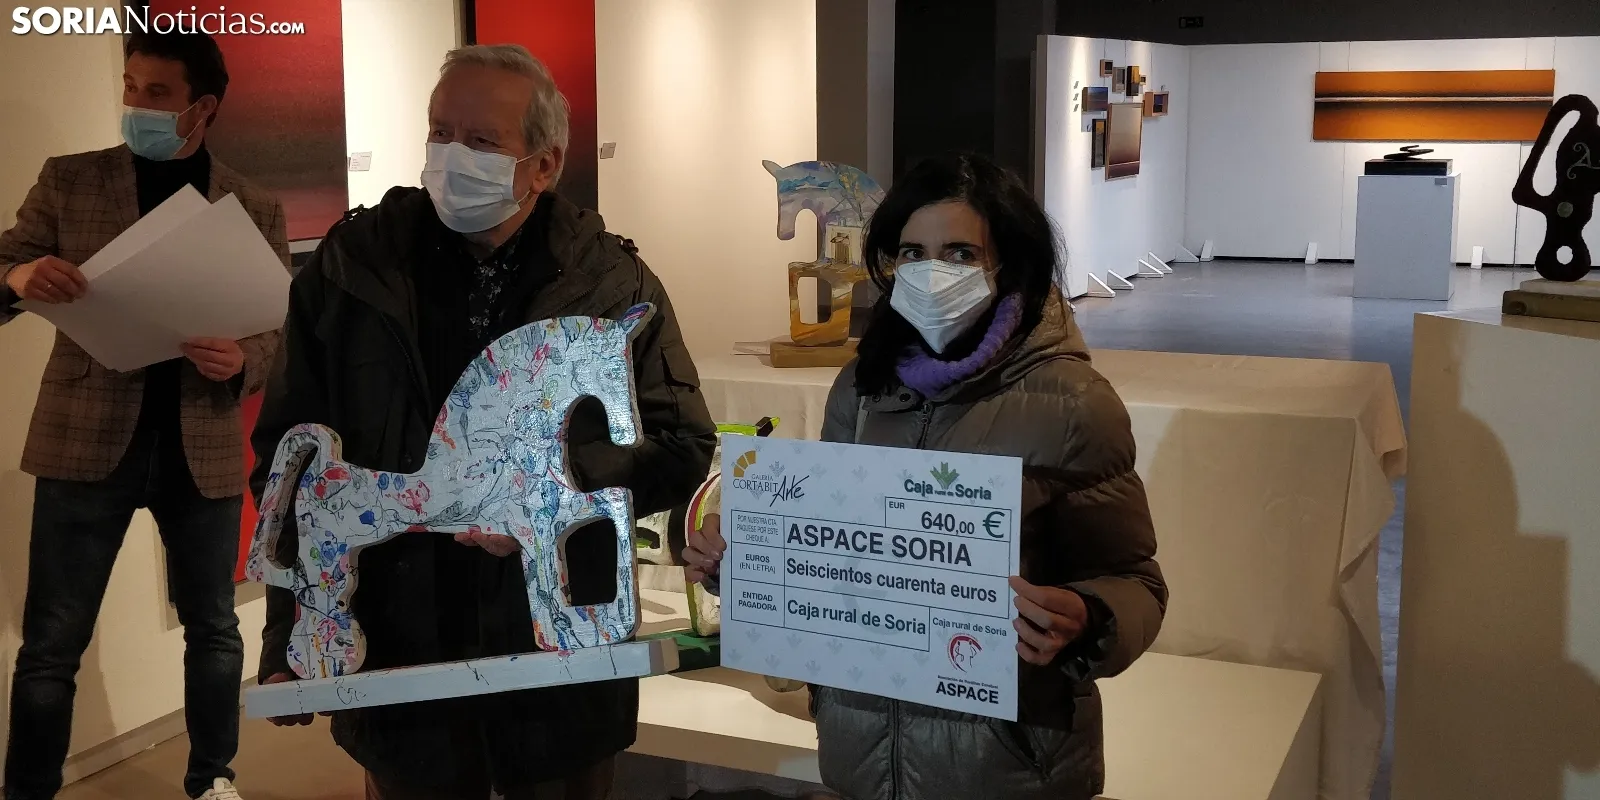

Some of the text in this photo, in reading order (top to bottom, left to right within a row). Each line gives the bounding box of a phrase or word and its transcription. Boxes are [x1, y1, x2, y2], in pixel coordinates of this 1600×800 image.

[904, 479, 933, 497] Caja
[955, 484, 992, 500] Soria
[889, 501, 905, 510] EUR
[748, 516, 767, 525] NUESTRA
[921, 511, 1005, 538] 640,00 €
[745, 534, 764, 543] CHEQUE
[768, 528, 779, 536] ESTE
[787, 523, 972, 567] ASPACE SORIA
[745, 553, 770, 563] EUROS
[740, 562, 776, 574] (EN LETRA)
[786, 557, 997, 603] Seiscientos cuarenta euros
[742, 591, 774, 602] ENTIDAD
[738, 599, 777, 612] PAGADORA
[787, 599, 926, 635] Caja rural de Soria
[932, 617, 1007, 637] Caja rural de Soria
[935, 681, 999, 705] ASPACE
